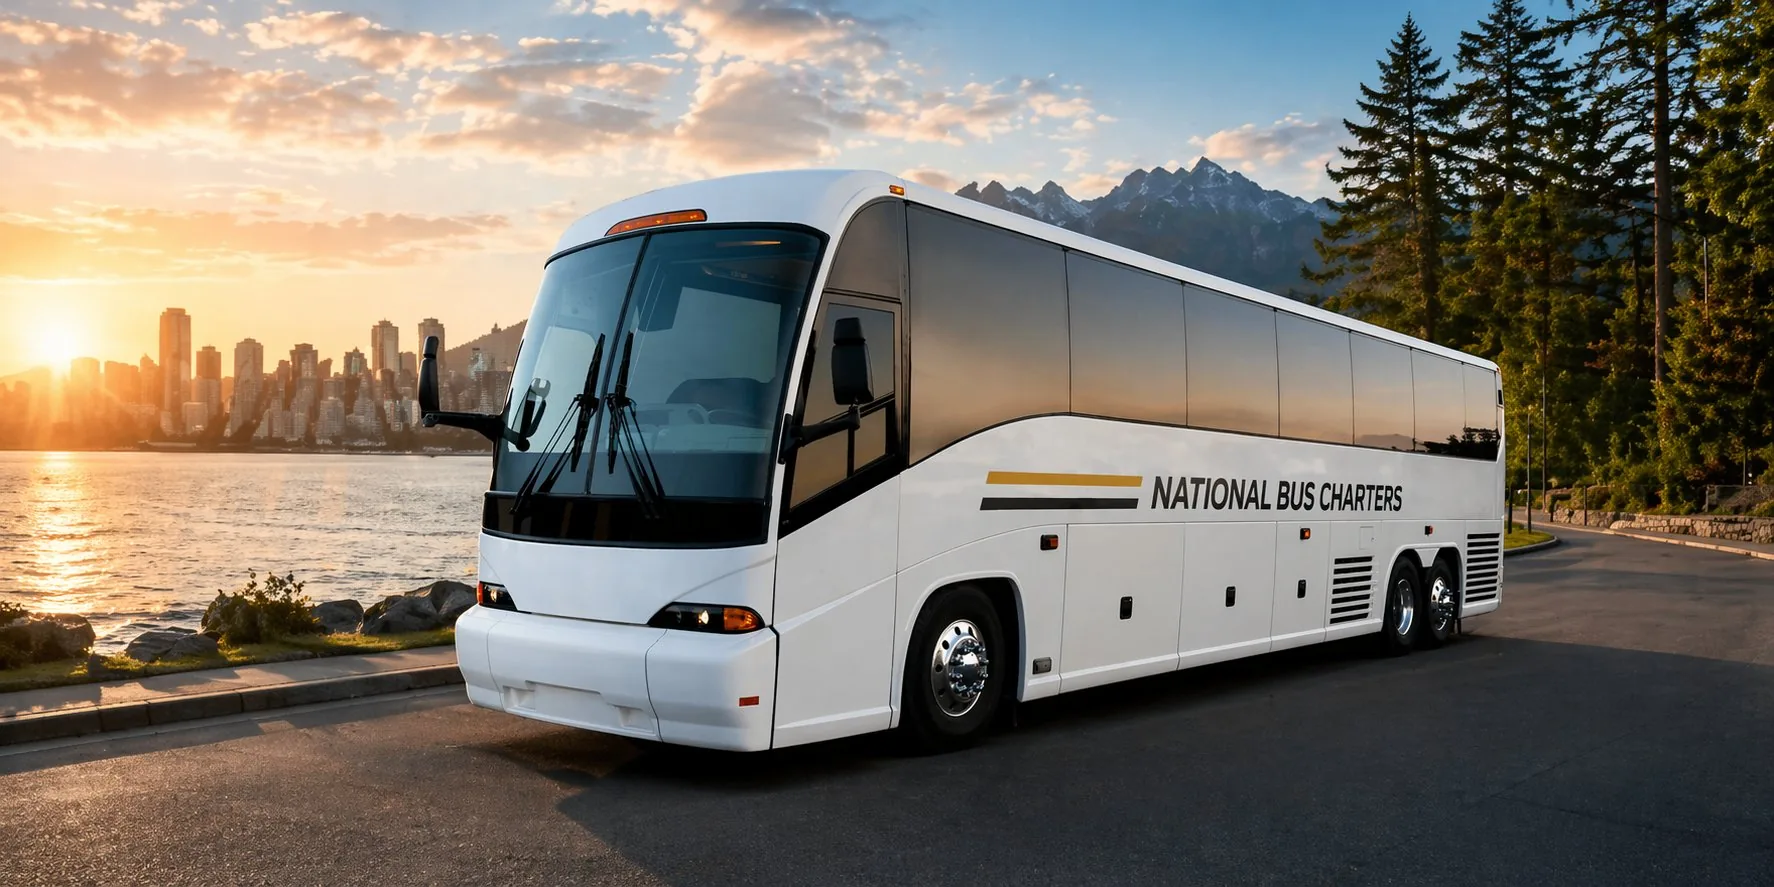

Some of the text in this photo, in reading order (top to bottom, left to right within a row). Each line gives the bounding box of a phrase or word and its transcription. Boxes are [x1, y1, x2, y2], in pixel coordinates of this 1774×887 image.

[1151, 476, 1402, 512] NATIONAL BUS CHARTERS
